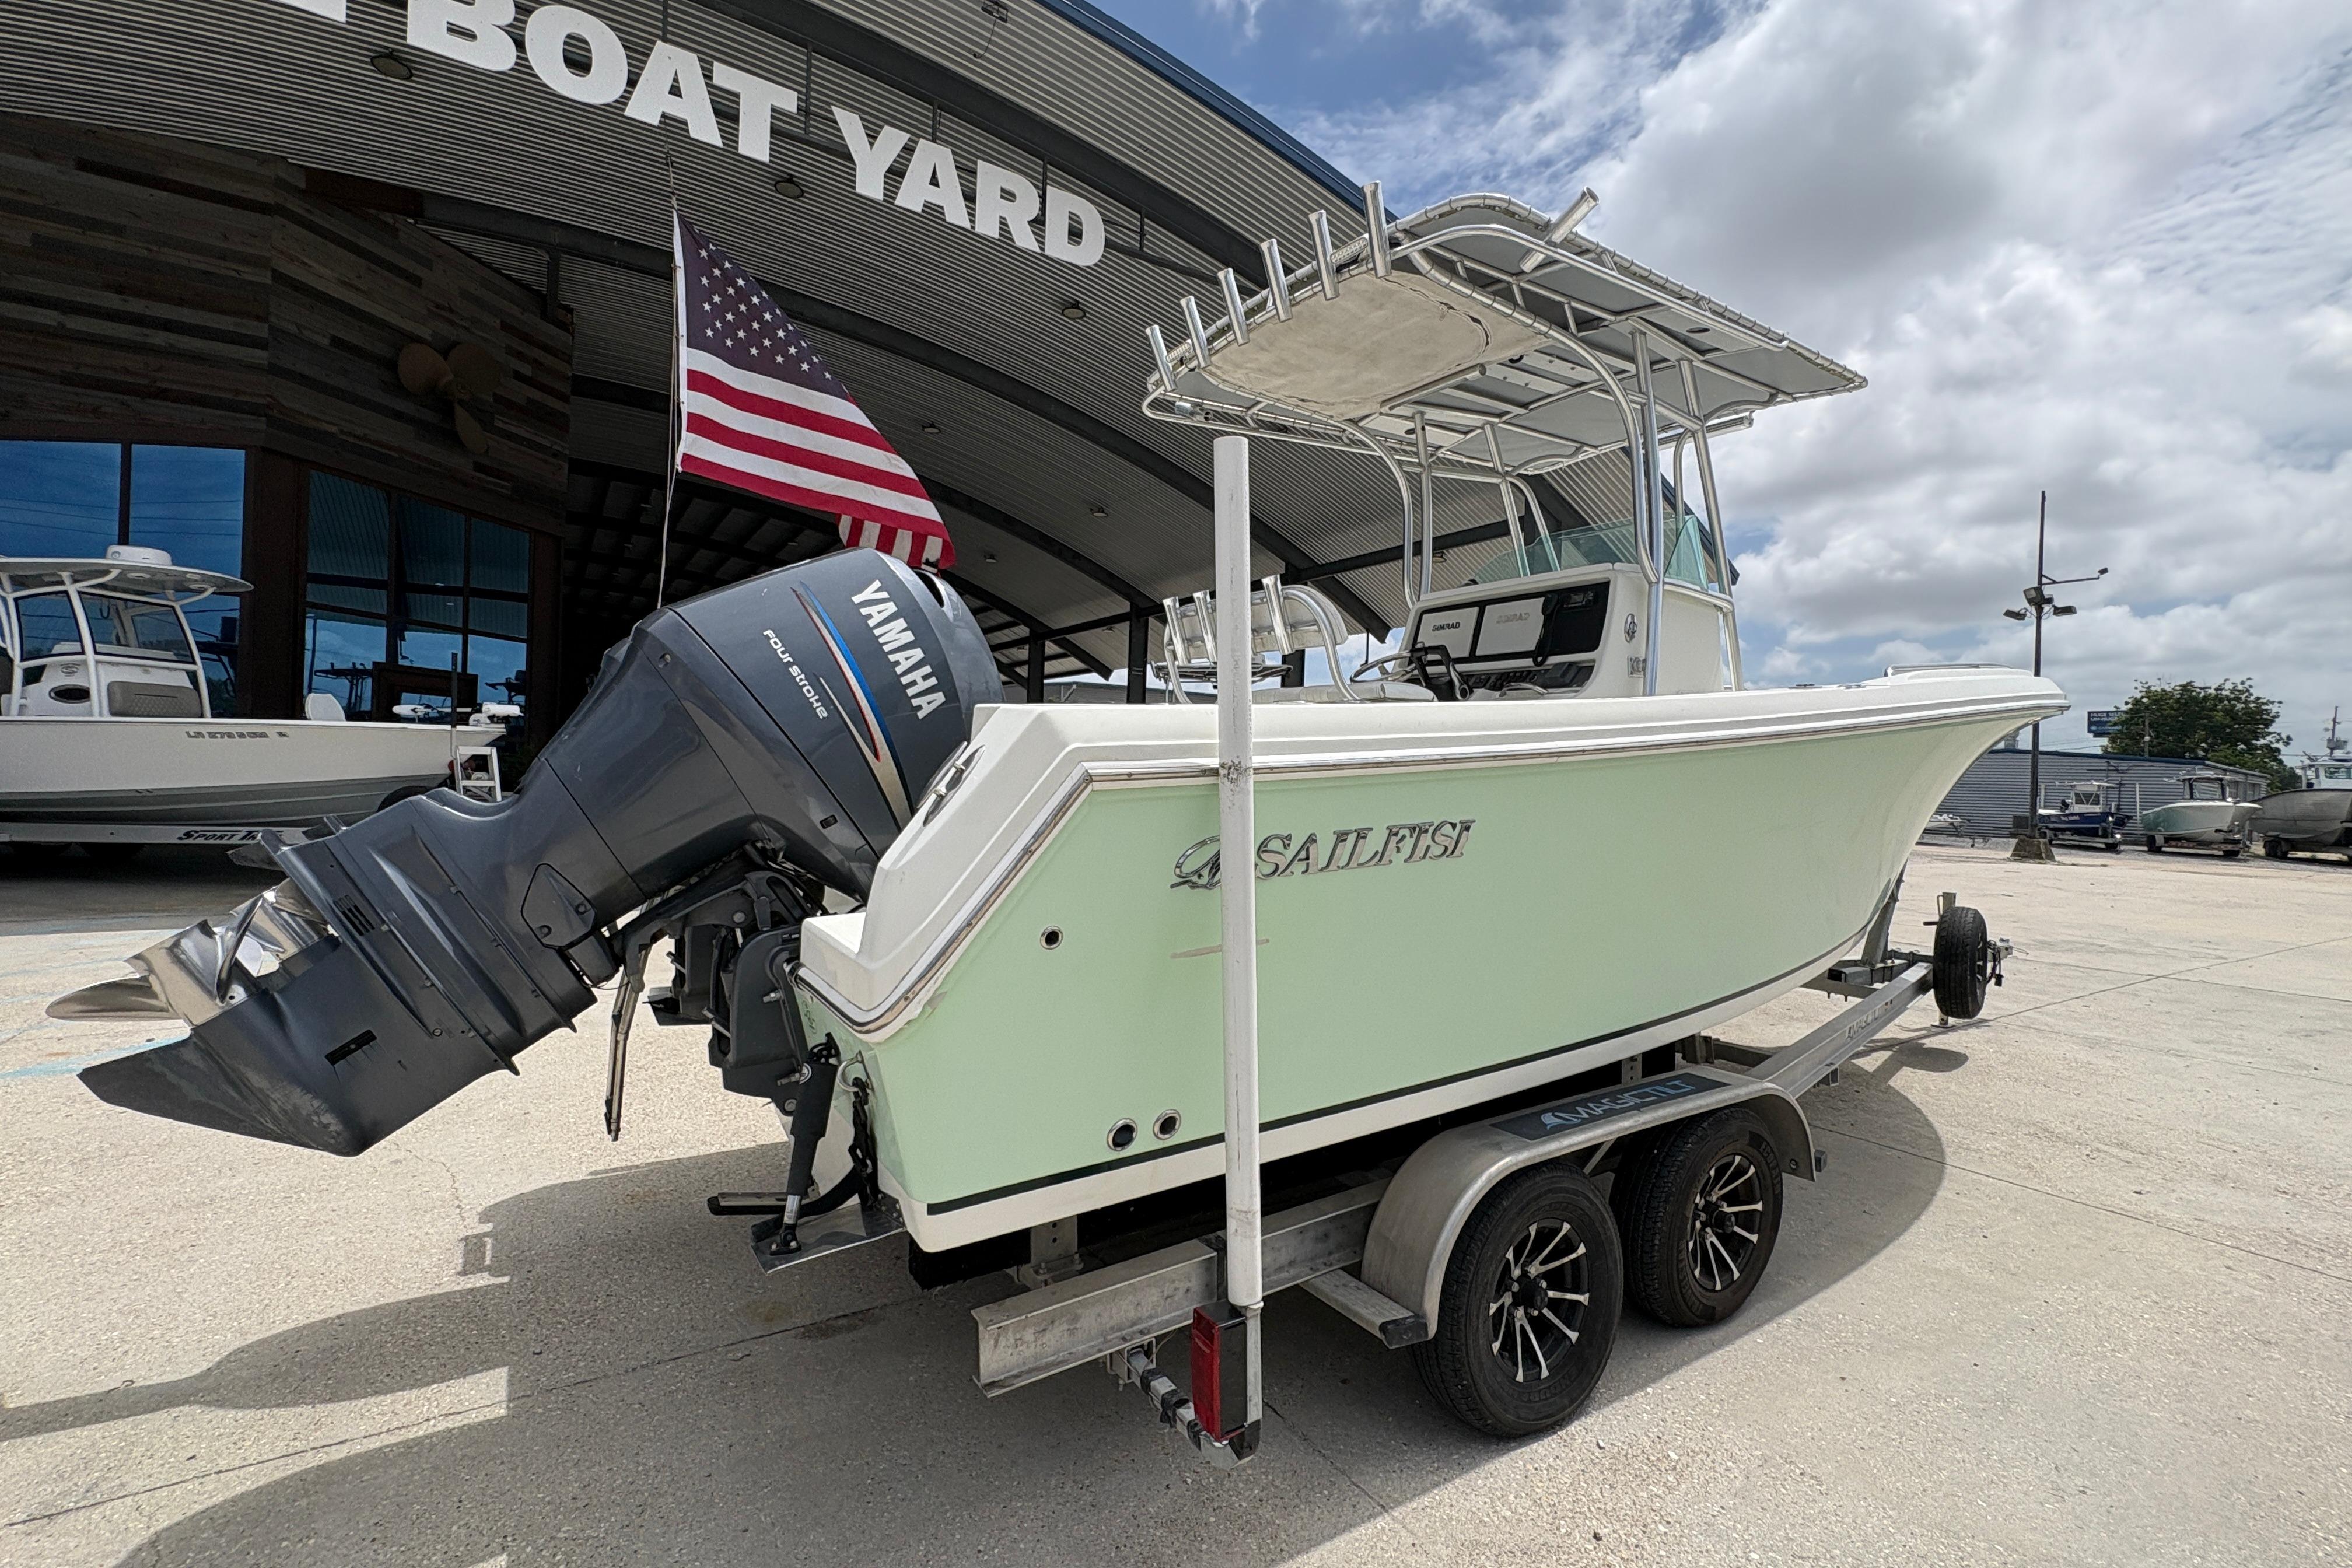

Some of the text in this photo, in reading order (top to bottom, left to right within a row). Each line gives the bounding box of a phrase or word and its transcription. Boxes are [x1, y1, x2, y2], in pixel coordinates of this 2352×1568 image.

[407, 0, 1106, 268] BOAT YARD
[851, 579, 946, 720] YAMAHA
[1432, 622, 1461, 632] SIMRAD
[177, 830, 242, 841] SPORT
